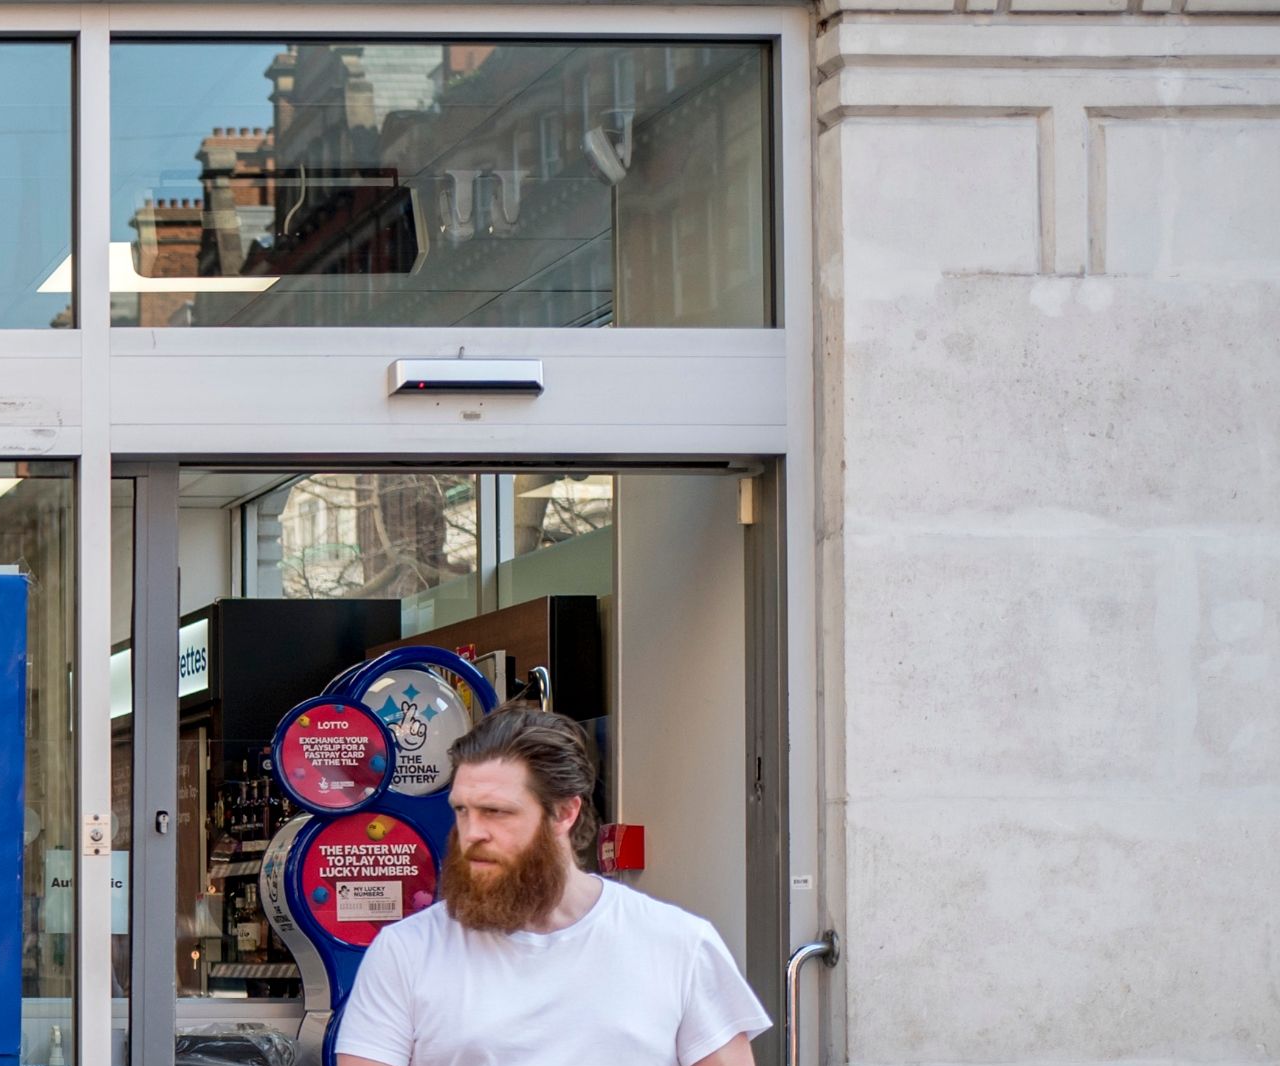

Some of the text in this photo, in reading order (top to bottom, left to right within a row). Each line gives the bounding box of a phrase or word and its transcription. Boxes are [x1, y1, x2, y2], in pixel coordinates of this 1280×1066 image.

[178, 646, 207, 679] ettes
[318, 722, 348, 730] LOTTO
[341, 758, 358, 766] TILL
[400, 755, 422, 764] THE
[394, 765, 439, 774] ATIONAL
[391, 774, 437, 784] OTTERY
[319, 844, 417, 855] THE FASTER WAY
[327, 855, 410, 866] TO PLAY YOUR
[320, 866, 419, 877] LUCKY NUMBERS
